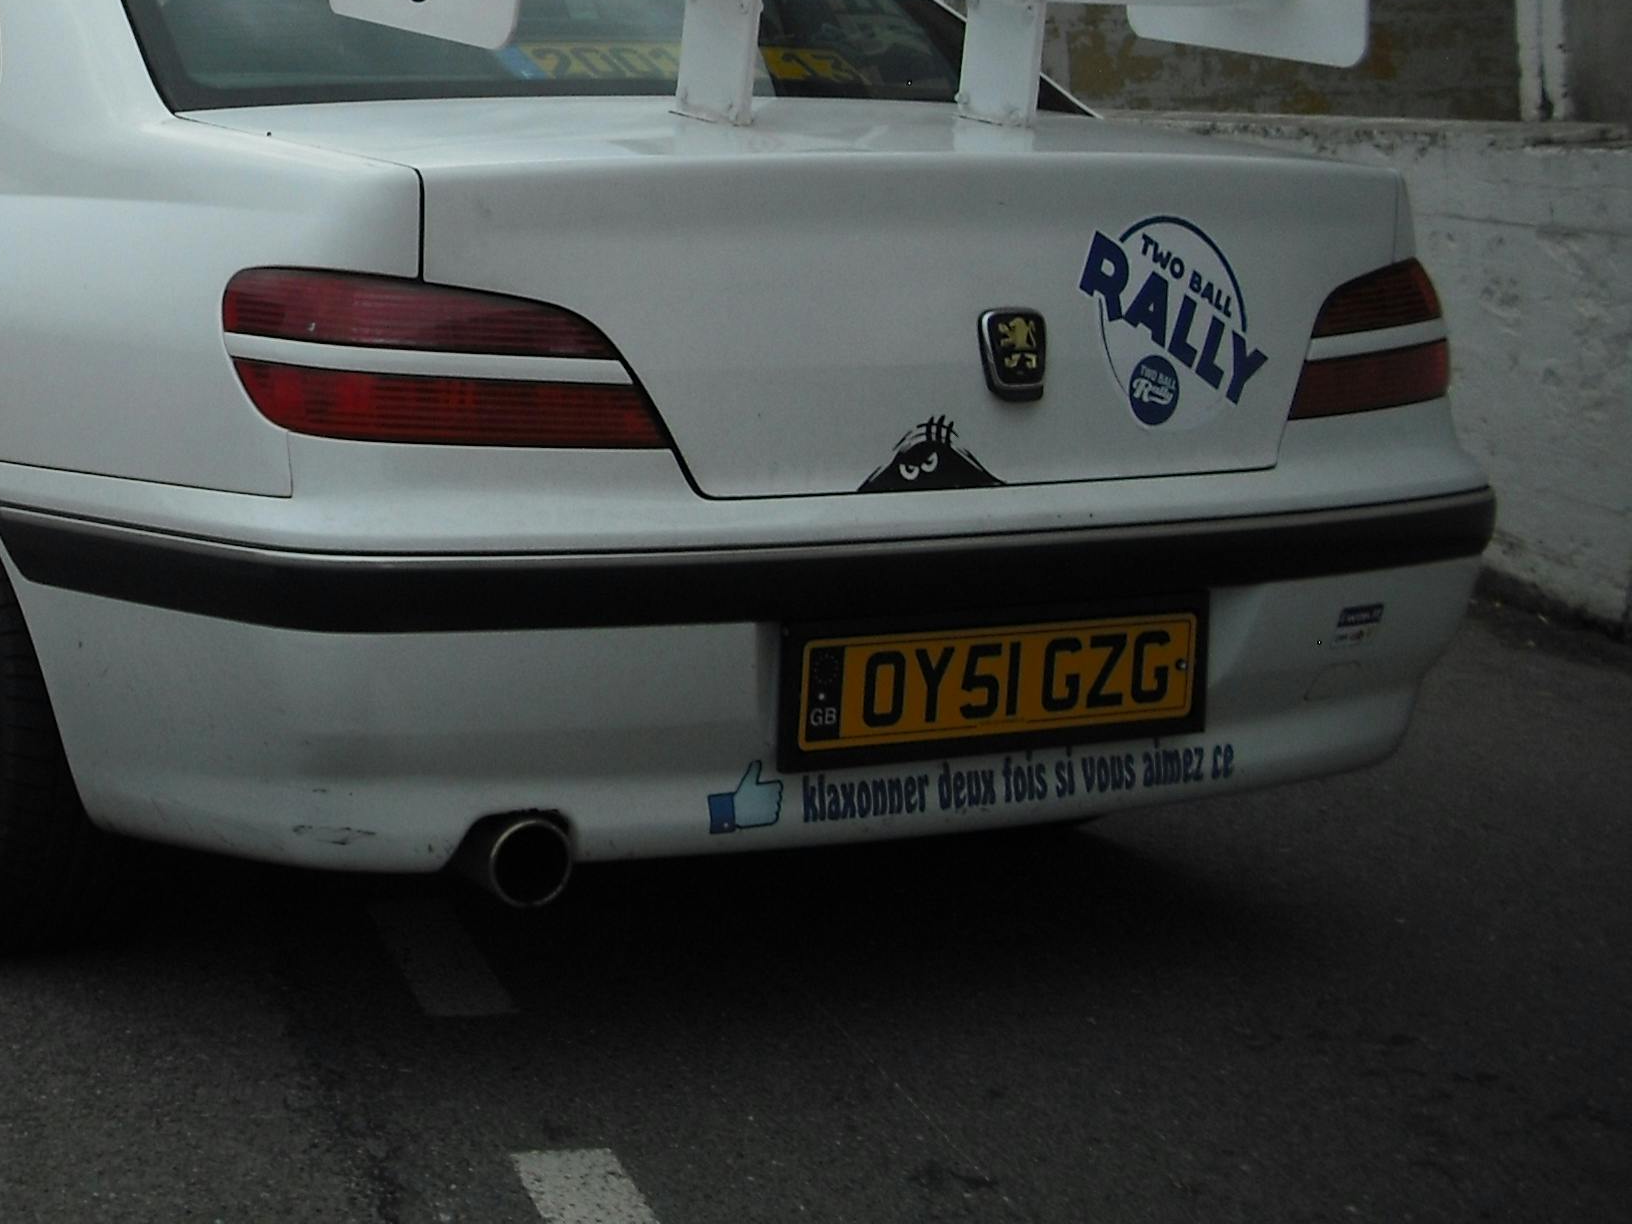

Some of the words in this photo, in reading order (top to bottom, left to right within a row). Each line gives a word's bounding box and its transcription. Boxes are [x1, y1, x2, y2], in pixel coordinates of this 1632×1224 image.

[1079, 230, 1269, 404] RALLY
[1141, 233, 1184, 279] TWO
[1189, 270, 1232, 318] BALL
[810, 705, 838, 728] GB
[863, 640, 1022, 728] OY51
[1041, 629, 1171, 713] GZG
[802, 774, 929, 823] klaxonner
[937, 762, 997, 810] deux
[1002, 751, 1048, 802] fois
[1055, 748, 1076, 799] si
[1081, 756, 1137, 793] vous
[1143, 737, 1205, 786] aimez
[1211, 742, 1235, 779] ce
